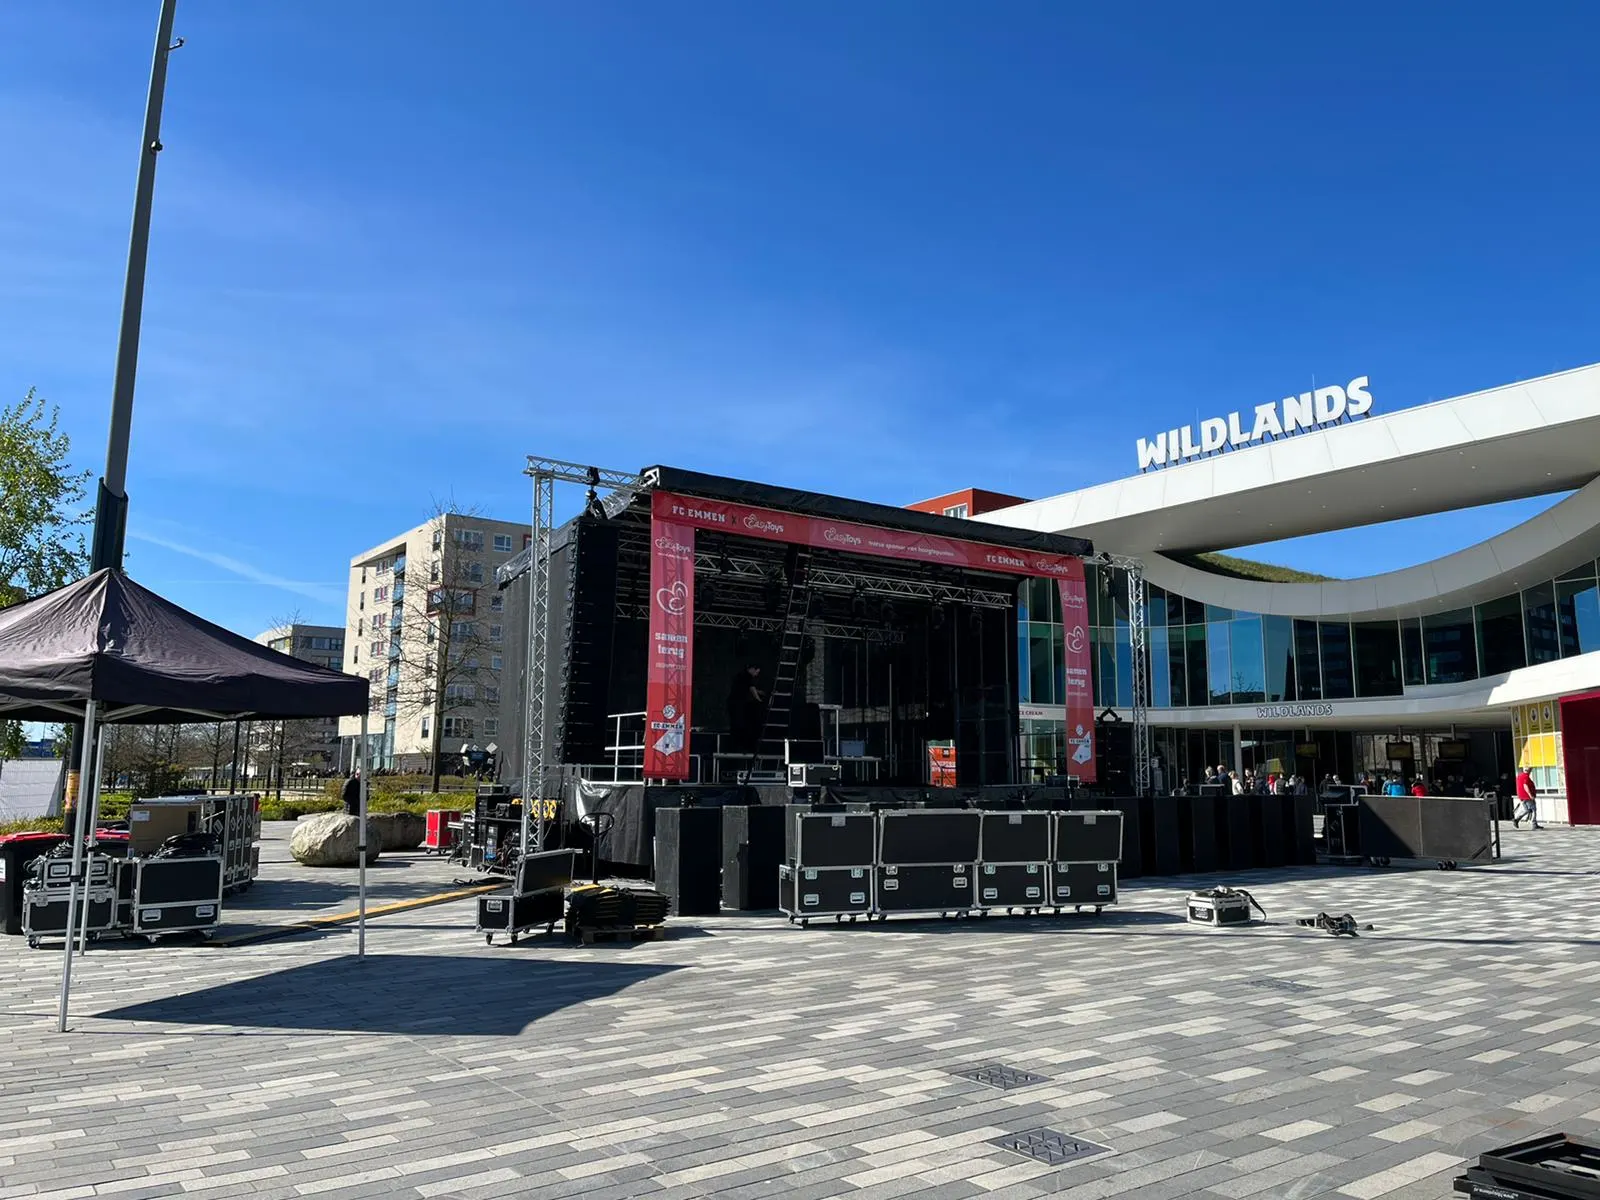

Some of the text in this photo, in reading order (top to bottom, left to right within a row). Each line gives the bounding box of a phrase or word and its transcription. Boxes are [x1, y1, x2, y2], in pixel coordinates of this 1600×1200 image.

[1136, 375, 1374, 469] WILDLANDS
[672, 505, 685, 516] FC
[687, 509, 726, 523] EMMEN
[743, 513, 784, 534] EasyToys
[823, 526, 862, 546] EasyToys
[986, 554, 997, 563] FC
[998, 556, 1025, 568] EMMEN
[655, 631, 689, 644] samen
[658, 643, 685, 659] terug
[1065, 667, 1087, 676] samen
[1067, 677, 1086, 688] terug
[1256, 703, 1334, 718] WILDLANDS
